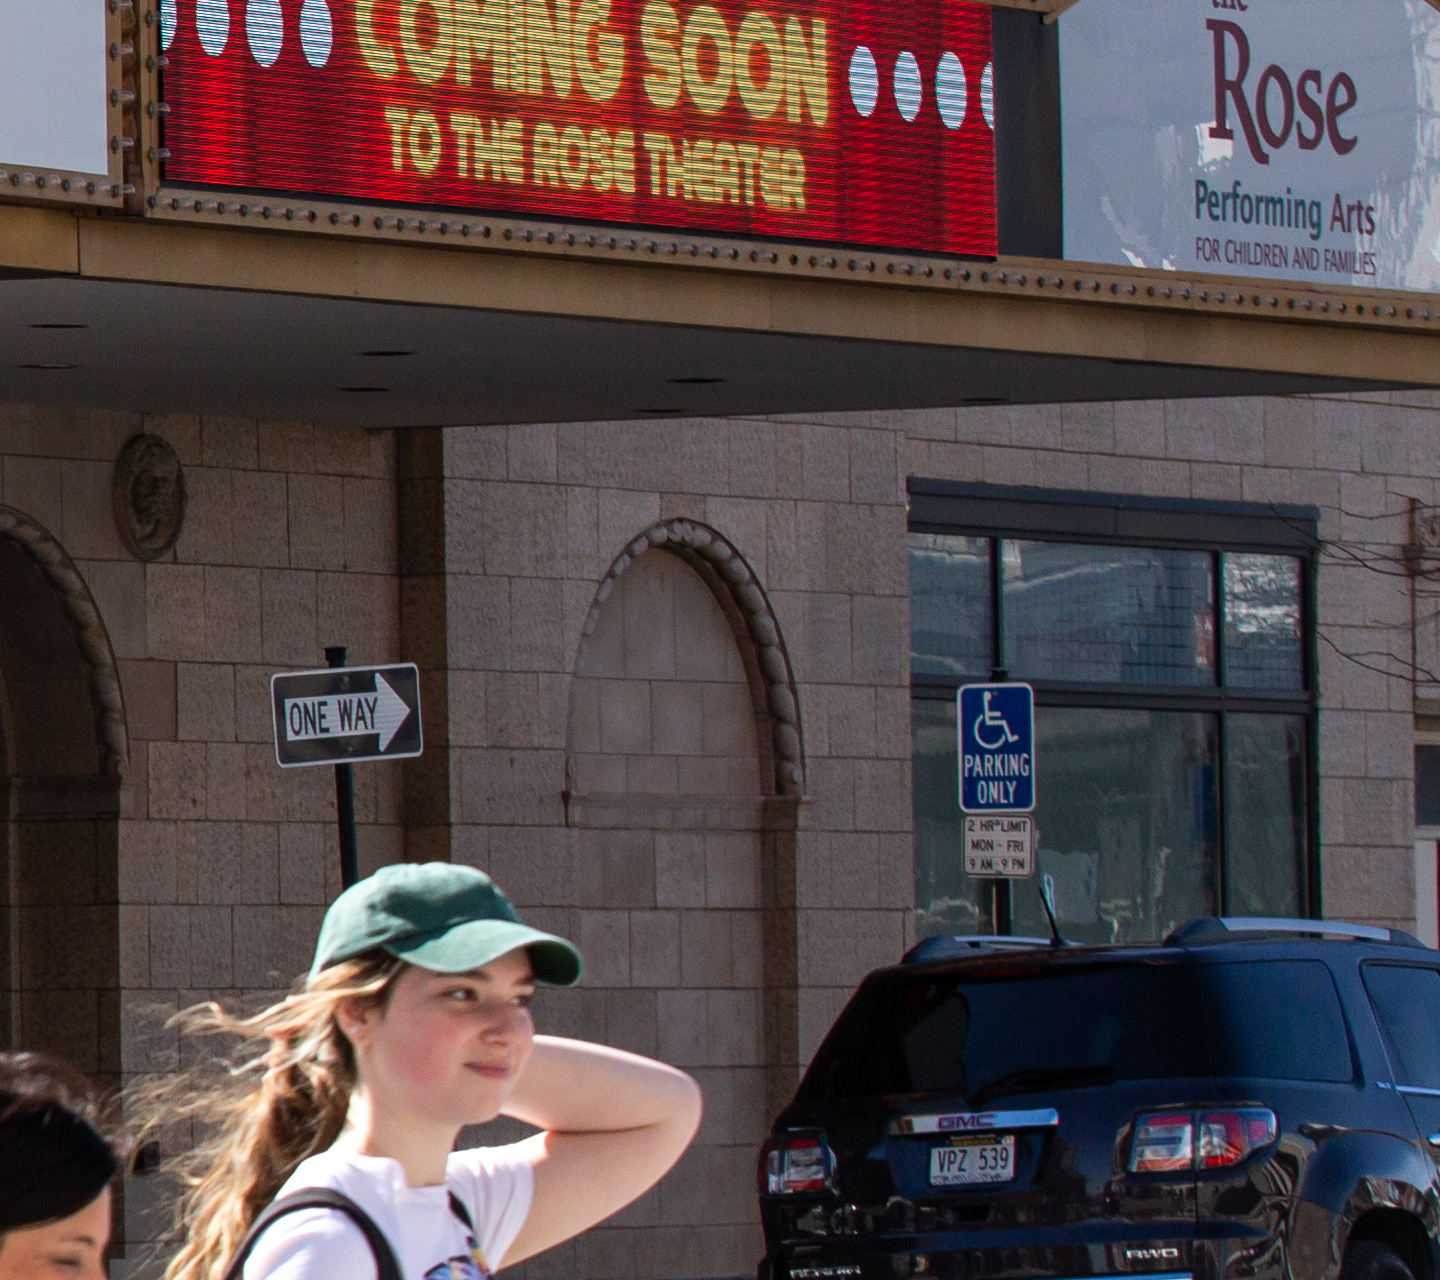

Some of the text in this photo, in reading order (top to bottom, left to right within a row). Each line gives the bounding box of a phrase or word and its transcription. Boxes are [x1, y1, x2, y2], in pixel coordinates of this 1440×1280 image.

[1205, 18, 1359, 165] Rose
[383, 105, 807, 211] TO THE ROSE THEATER
[1194, 179, 1376, 241] Performing Arts
[1196, 236, 1377, 277] FOR CHILDREN AND FAMILIES
[290, 697, 378, 736] ONE WAY
[964, 753, 1029, 777] PARKING
[977, 781, 1017, 804] ONLY
[968, 819, 975, 832] 2
[1001, 820, 1028, 832] LIMIT
[971, 839, 994, 851] MON
[1006, 840, 1024, 852] FRI
[938, 1114, 995, 1129] GMC
[937, 1147, 1009, 1173] VPZ 539
